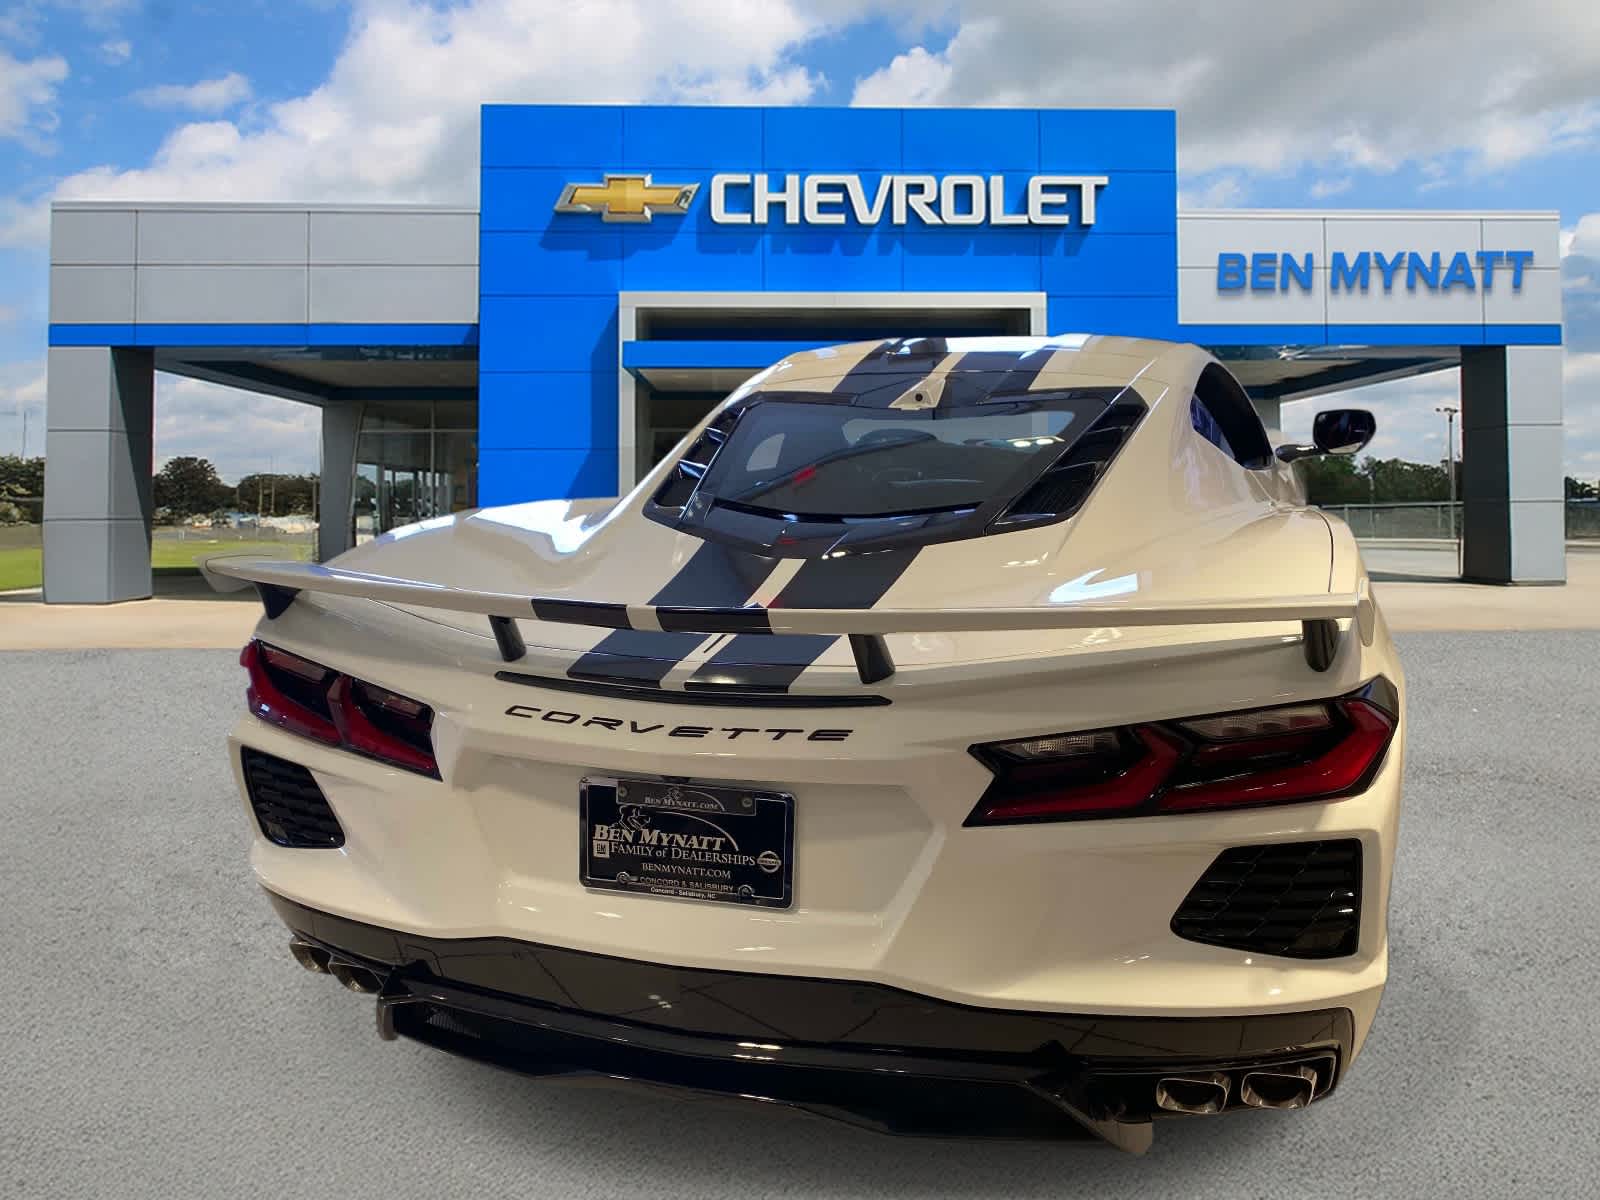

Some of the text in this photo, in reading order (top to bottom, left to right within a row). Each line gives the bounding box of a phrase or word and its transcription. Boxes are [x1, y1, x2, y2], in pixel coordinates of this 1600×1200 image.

[711, 174, 1109, 225] CHEVROLET
[1217, 250, 1534, 290] BEN MYNATT
[505, 704, 854, 742] CORVETTE
[593, 824, 726, 851] BEN MYNATT
[611, 842, 654, 857] FAMILY
[655, 848, 667, 858] of
[672, 848, 756, 866] DEALERSHIPS
[641, 862, 731, 879] BENMYNATT.COM
